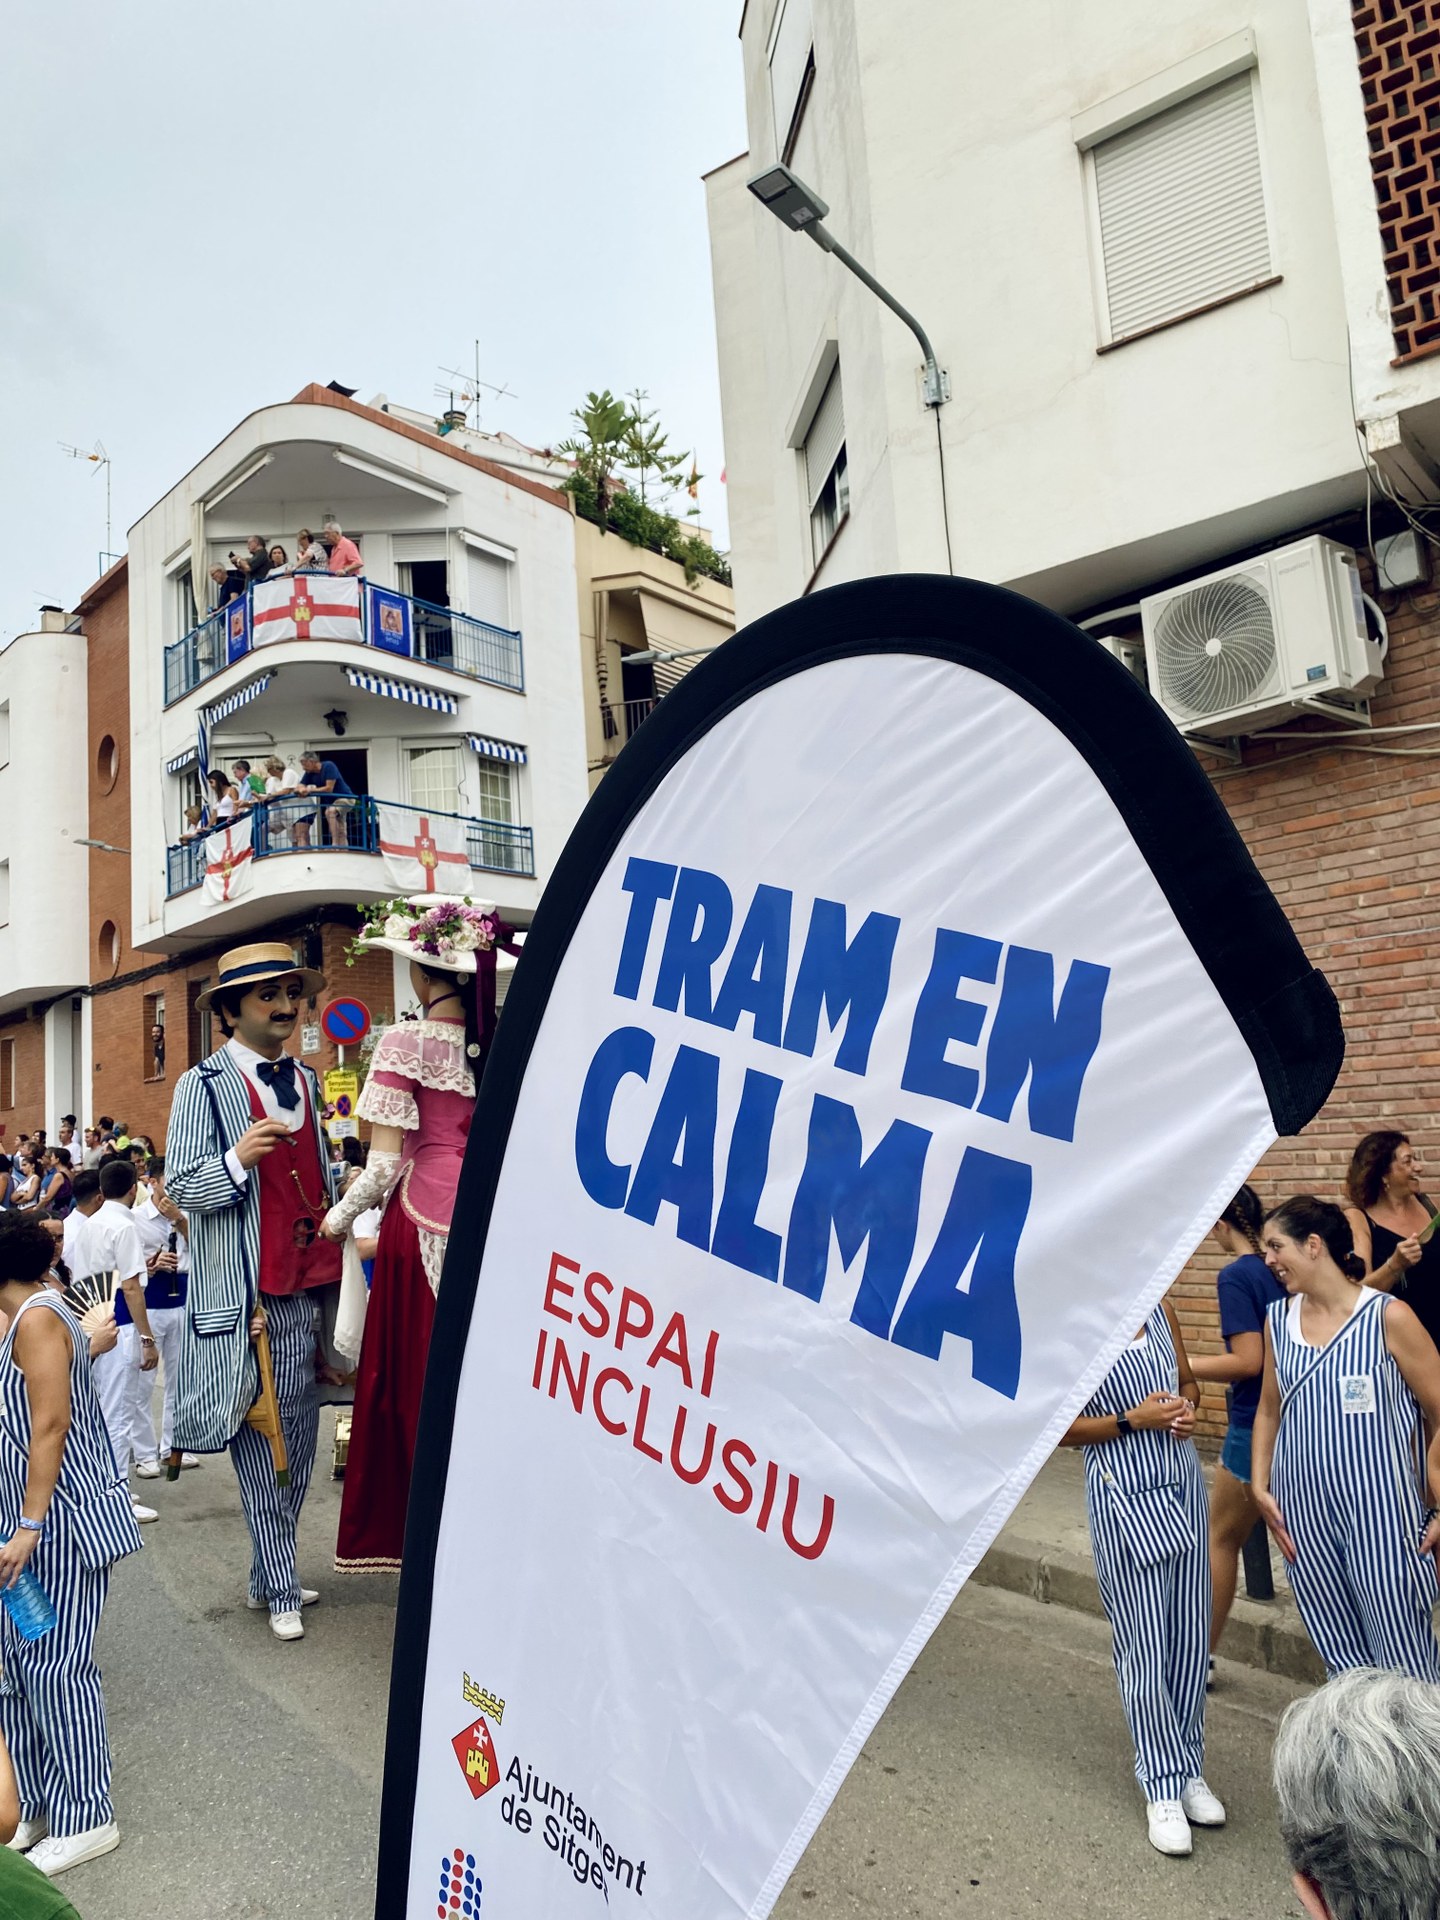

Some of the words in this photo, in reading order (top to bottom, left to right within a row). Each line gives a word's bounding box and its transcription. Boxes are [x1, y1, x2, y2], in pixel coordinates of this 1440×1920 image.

[613, 856, 901, 1077] TRAM
[900, 927, 1111, 1143] EN
[575, 1026, 1032, 1401] CALMA
[543, 1251, 720, 1398] ESPAI
[532, 1328, 835, 1560] INCLUSIU
[501, 1794, 532, 1834] de
[505, 1756, 647, 1896] Ajuntament
